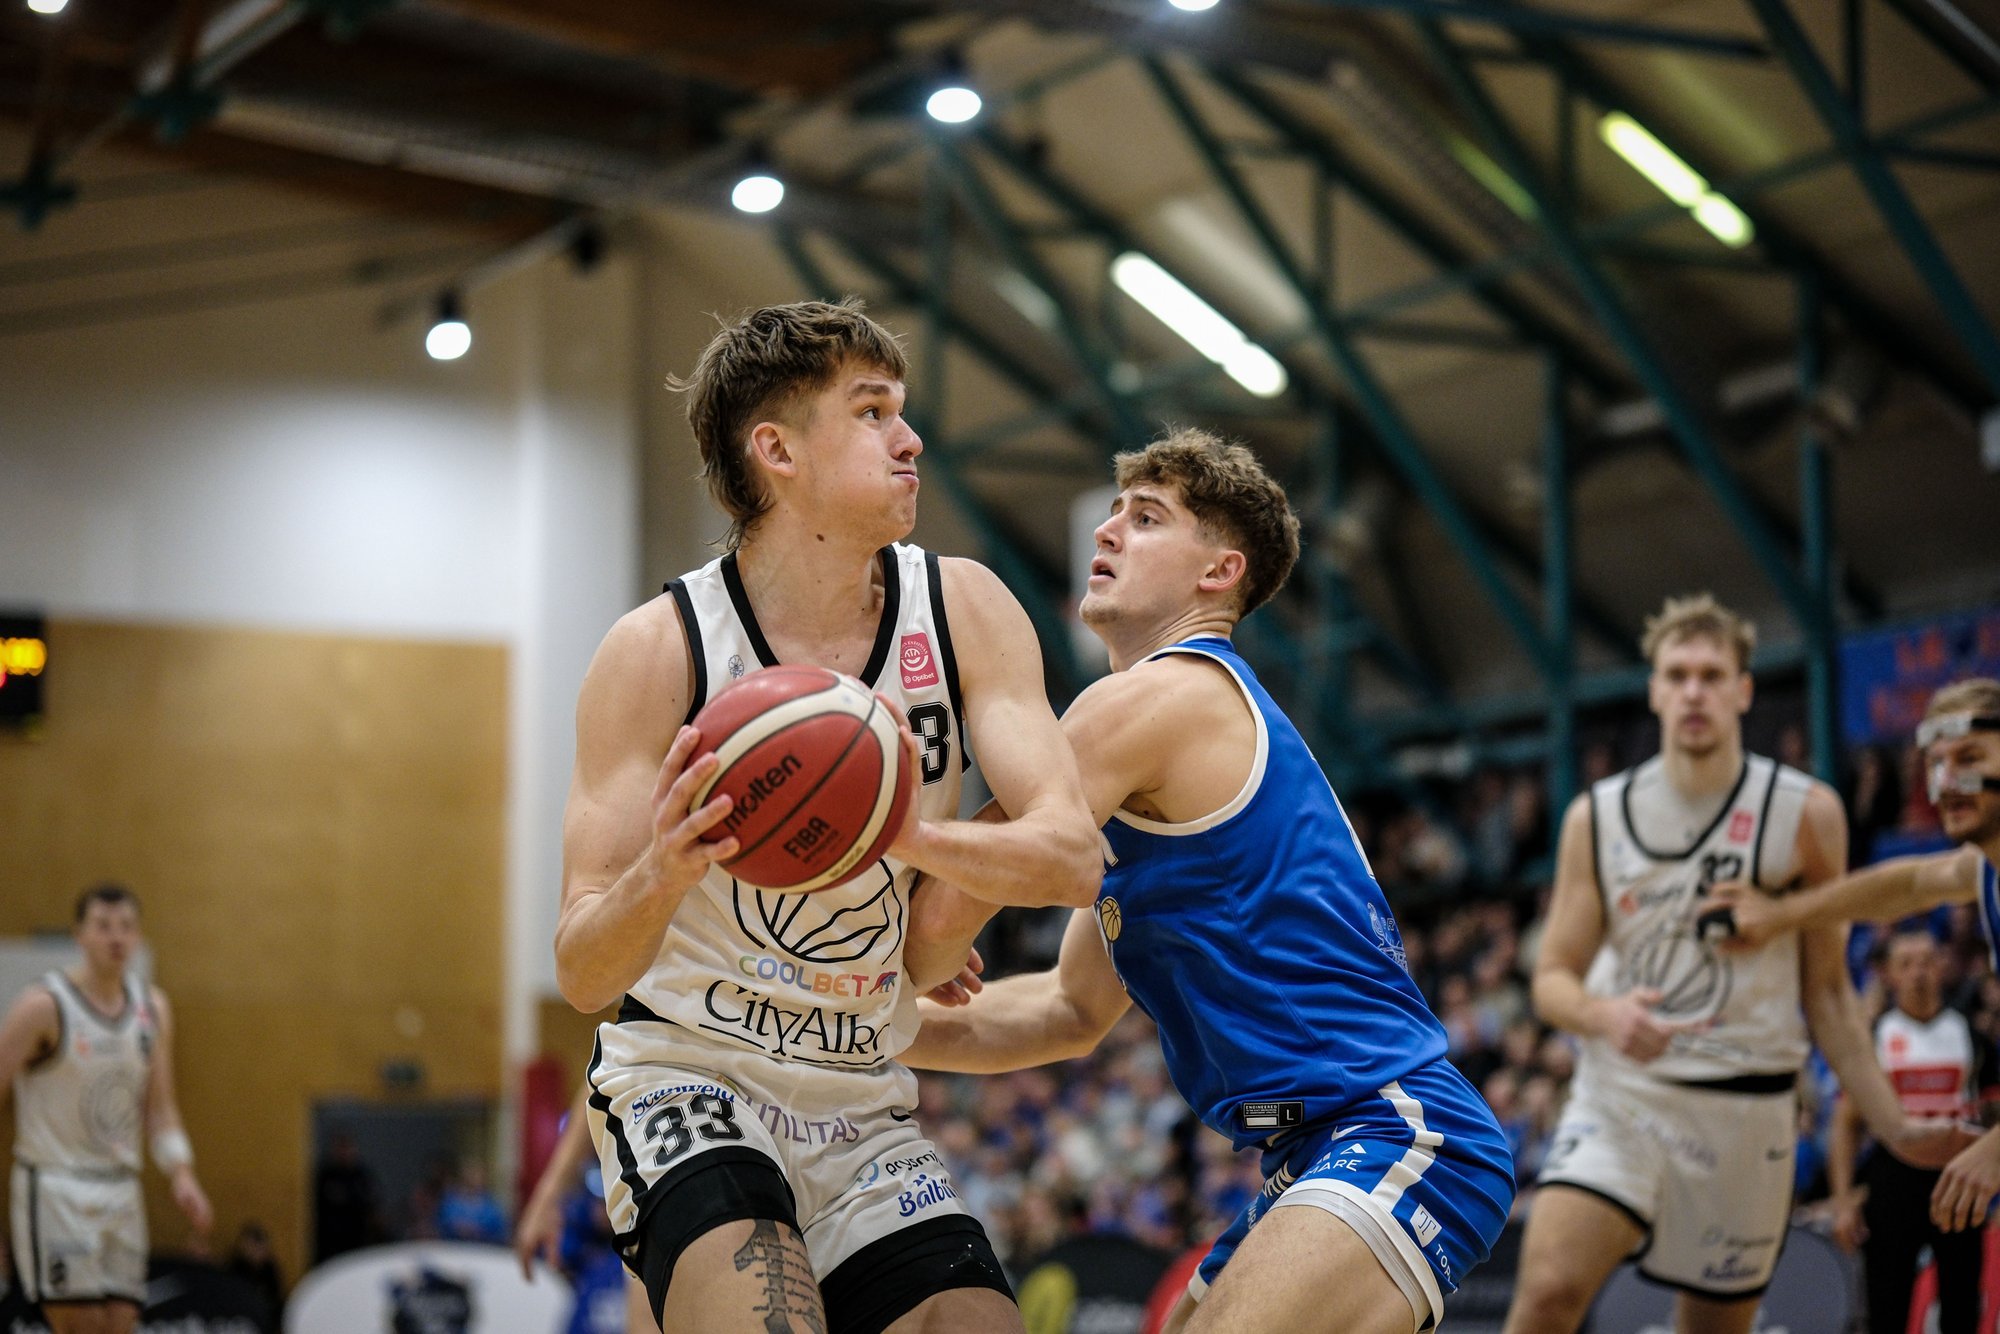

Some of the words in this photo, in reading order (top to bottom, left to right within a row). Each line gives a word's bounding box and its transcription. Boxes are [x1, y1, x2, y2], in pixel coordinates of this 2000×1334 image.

[911, 672, 935, 682] Optibet
[723, 754, 802, 833] molten
[783, 816, 831, 859] FIBA
[739, 955, 870, 998] COOLBET
[643, 1092, 746, 1168] 33
[1286, 1108, 1295, 1121] L
[885, 1149, 944, 1177] prysmi
[897, 1177, 957, 1218] Balbii
